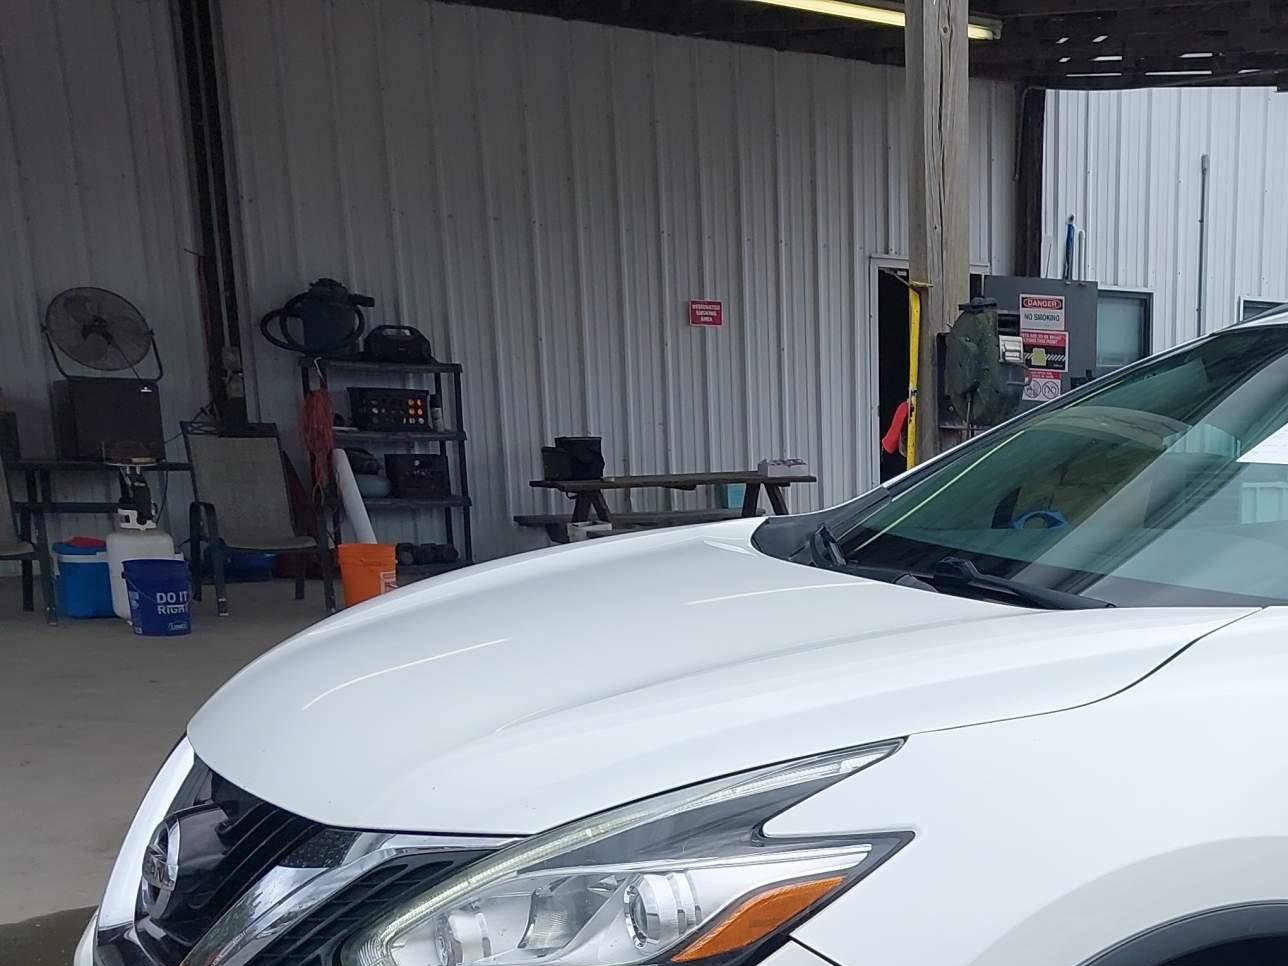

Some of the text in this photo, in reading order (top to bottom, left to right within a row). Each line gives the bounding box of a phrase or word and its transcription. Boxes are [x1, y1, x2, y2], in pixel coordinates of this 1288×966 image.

[1028, 299, 1057, 309] DANGER
[1034, 313, 1060, 322] SMOKING
[156, 591, 187, 603] DO IT
